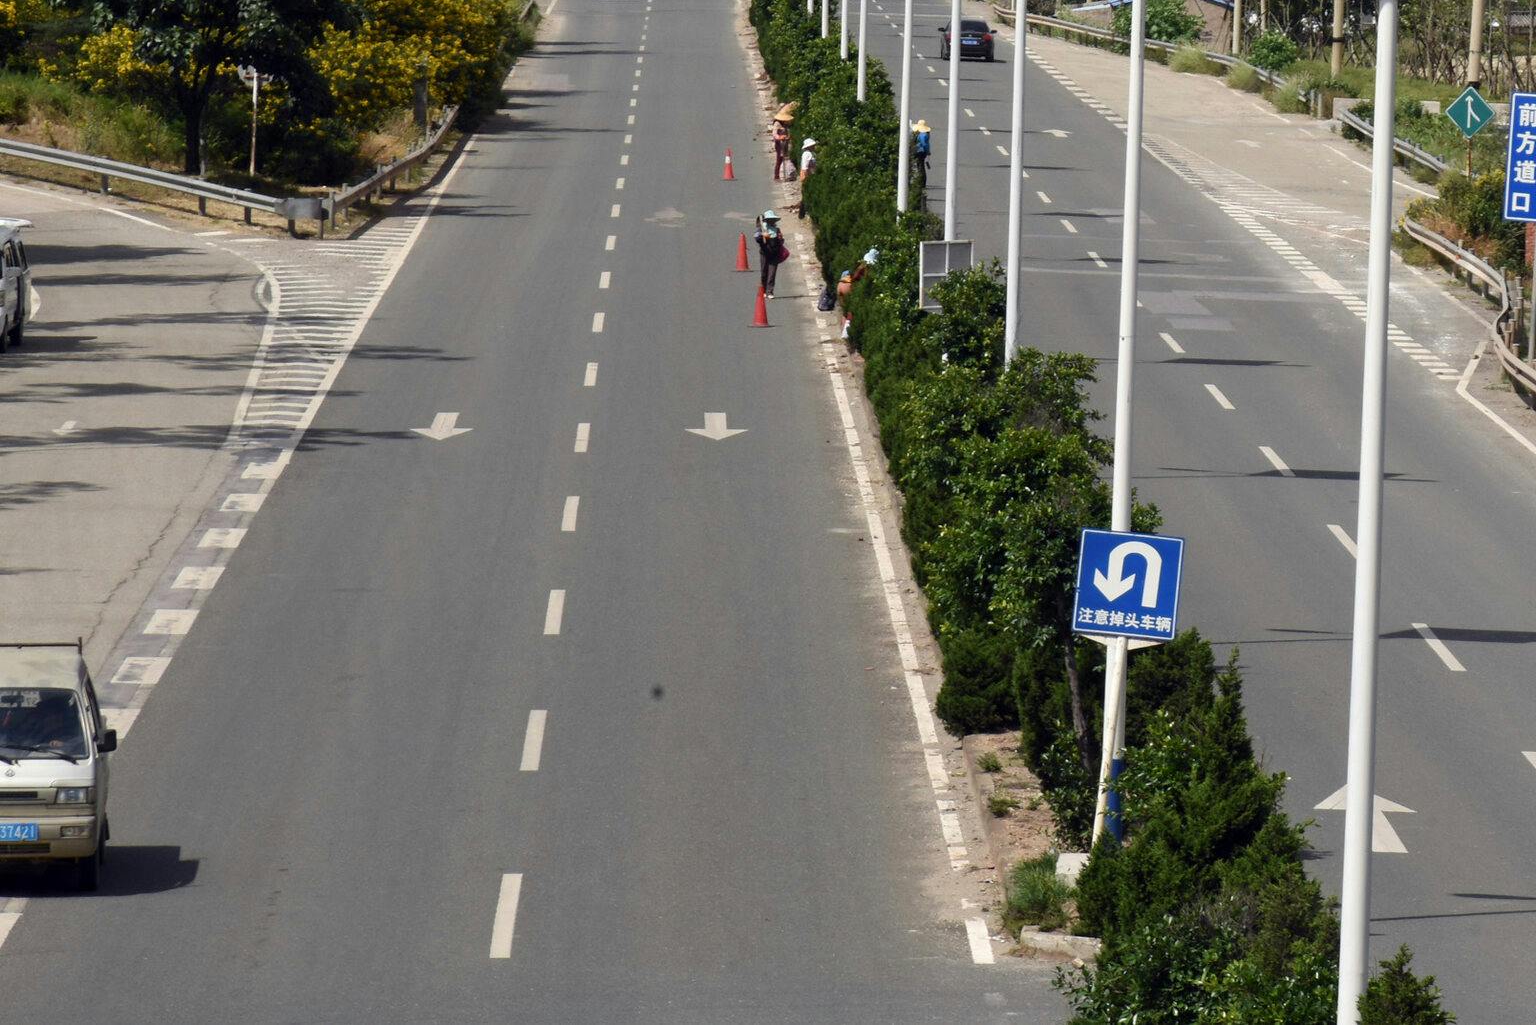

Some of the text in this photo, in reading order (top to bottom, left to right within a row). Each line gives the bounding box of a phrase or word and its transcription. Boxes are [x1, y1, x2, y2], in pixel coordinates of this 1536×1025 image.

[1078, 607, 1172, 633] 注意掉头车辆
